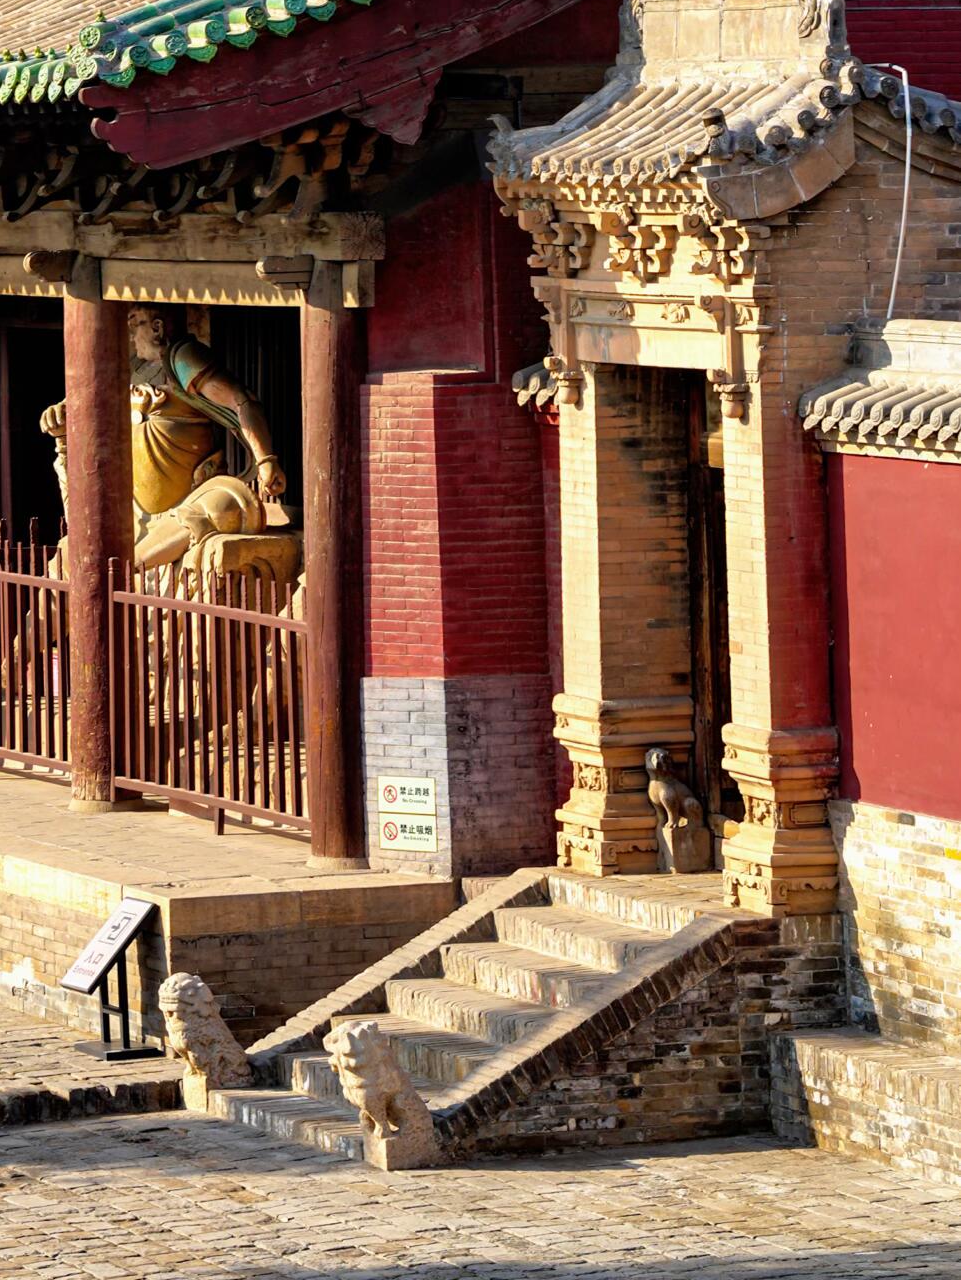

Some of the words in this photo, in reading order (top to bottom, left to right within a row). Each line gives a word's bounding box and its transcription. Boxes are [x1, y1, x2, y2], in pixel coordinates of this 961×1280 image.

[399, 786, 430, 797] 禁止跨越
[400, 824, 433, 835] 禁止吸烟
[83, 950, 104, 965] 入口
